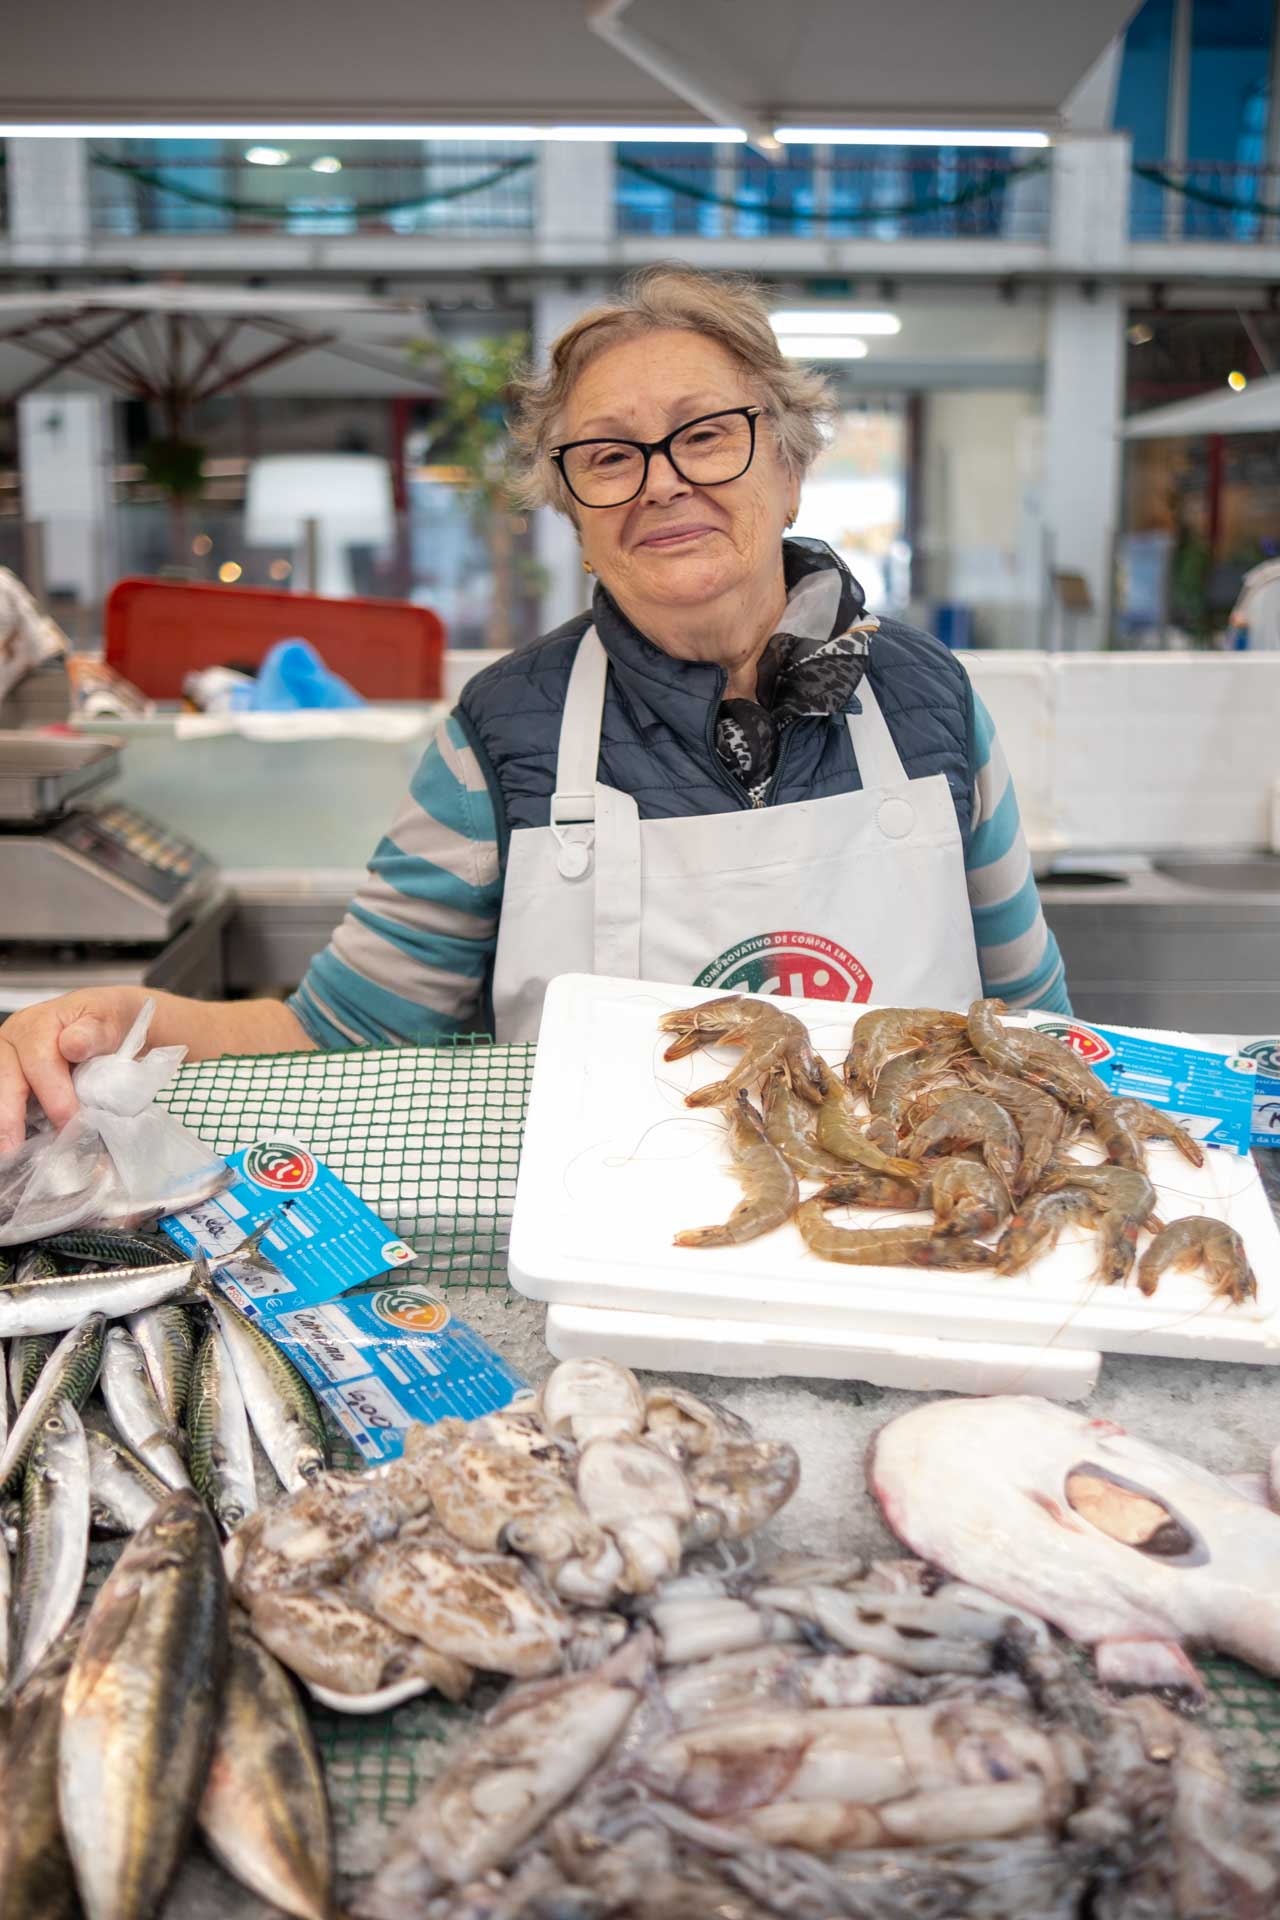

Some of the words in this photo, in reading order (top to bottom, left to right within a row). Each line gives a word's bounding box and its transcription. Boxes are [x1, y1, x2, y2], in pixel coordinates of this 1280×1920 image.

[701, 938, 772, 987] COMPROVATIVO
[775, 934, 788, 944] DE
[791, 935, 832, 952] COMPRA
[833, 948, 848, 961] EM
[847, 959, 866, 981] LOTA
[347, 1388, 393, 1430] 6,00
